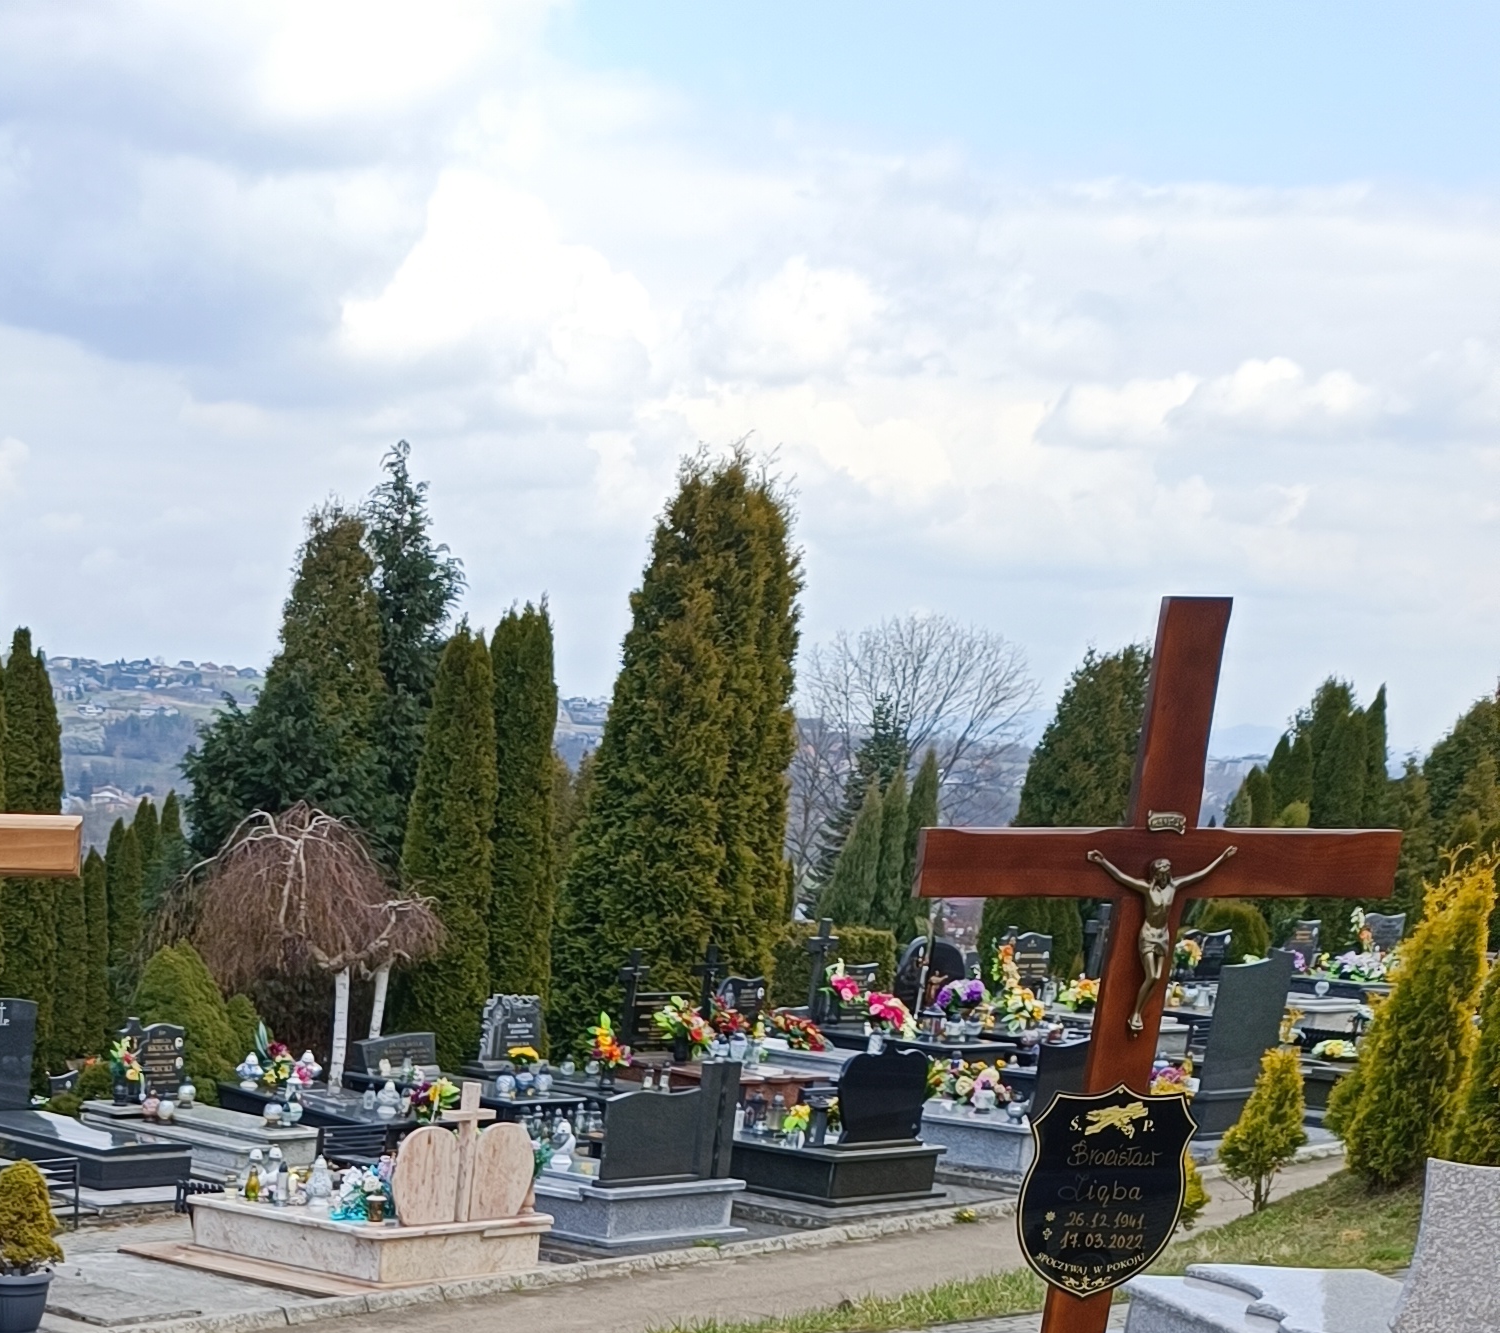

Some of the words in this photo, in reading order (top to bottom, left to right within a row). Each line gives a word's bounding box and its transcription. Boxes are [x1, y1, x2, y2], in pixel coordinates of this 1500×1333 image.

[1069, 1115, 1082, 1131] Ś.
[1142, 1119, 1155, 1132] P.
[1035, 1252, 1088, 1275] SPOCZYWAJ
[1093, 1265, 1104, 1274] W
[1106, 1253, 1146, 1273] POKOJU
